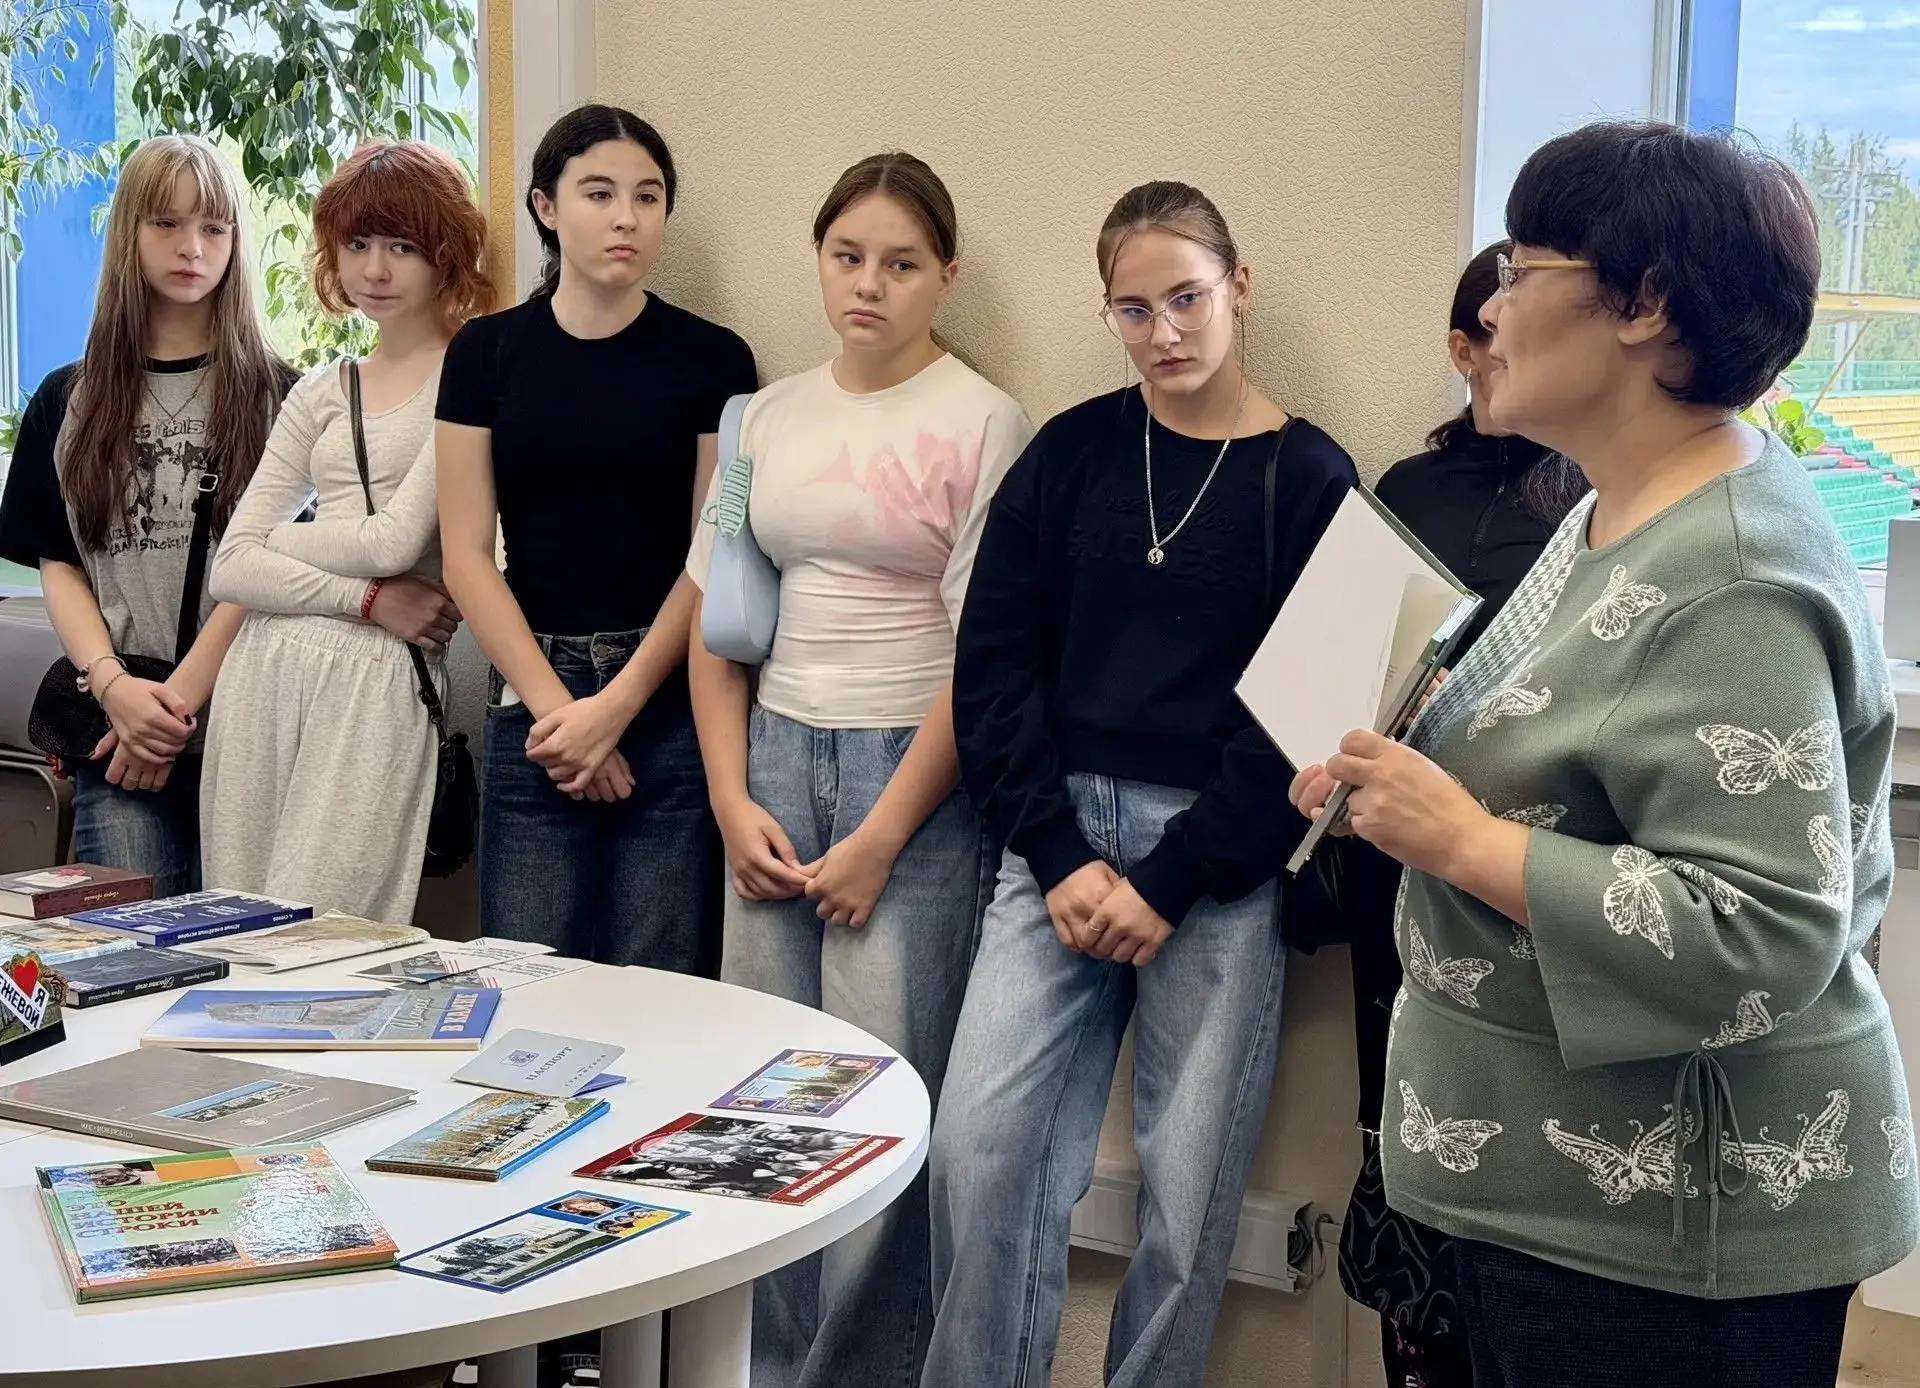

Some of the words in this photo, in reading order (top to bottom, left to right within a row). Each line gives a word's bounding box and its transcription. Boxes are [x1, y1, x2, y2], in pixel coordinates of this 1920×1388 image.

[34, 987, 46, 1008] Я
[439, 1024, 464, 1033] В
[525, 1046, 573, 1081] ПАСПОРТ
[67, 1199, 127, 1212] ЭТО
[69, 1201, 185, 1221] НАШЕЙ
[73, 1207, 220, 1229] ИСТОРИИ
[77, 1218, 200, 1238] СТРОКИ
